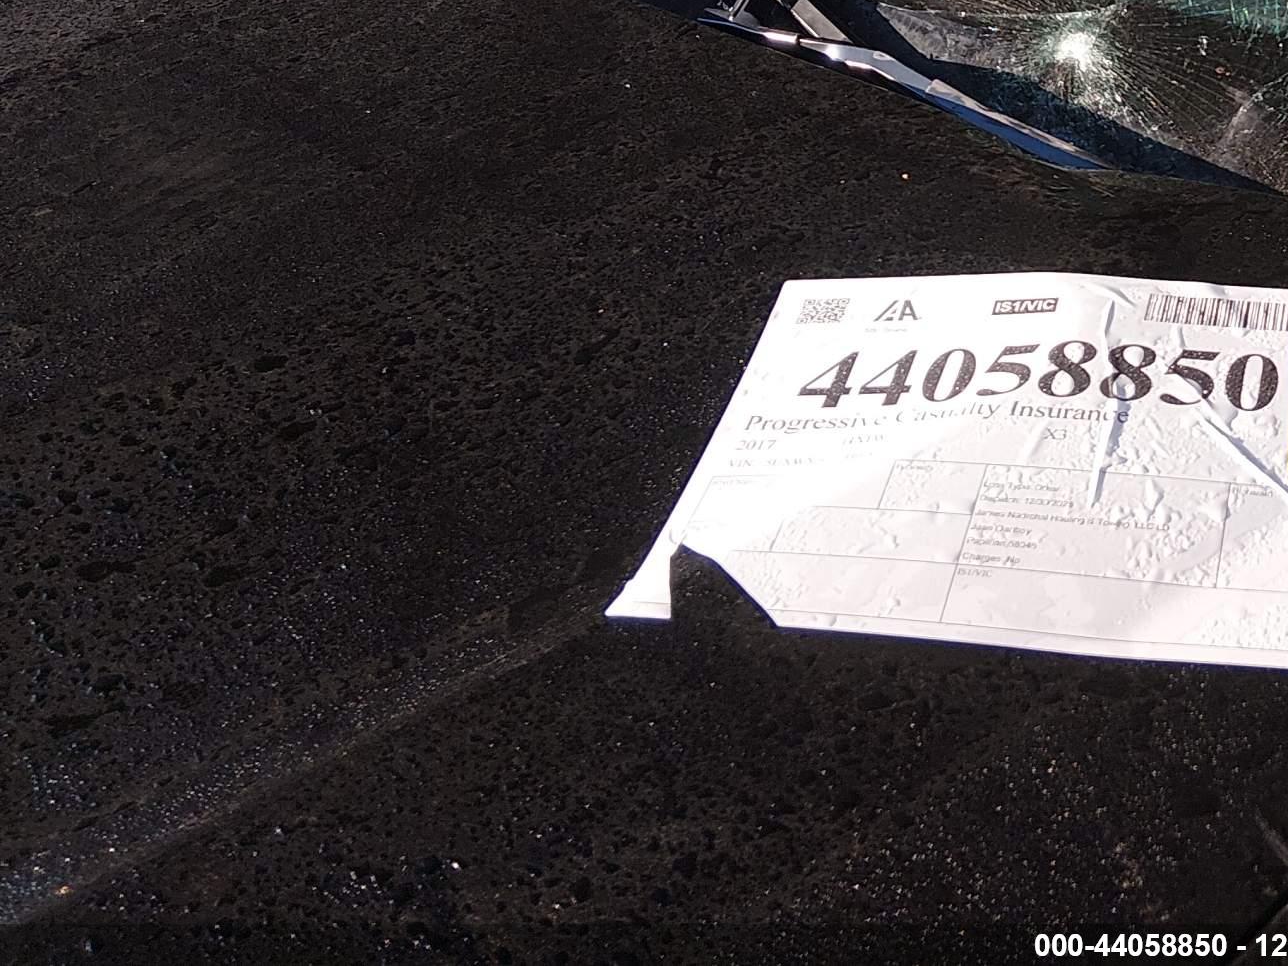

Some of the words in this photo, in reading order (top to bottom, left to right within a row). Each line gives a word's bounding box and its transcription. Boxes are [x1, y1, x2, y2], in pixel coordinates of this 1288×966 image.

[797, 340, 1278, 412] 44058850
[1008, 399, 1130, 423] Insurance
[1044, 427, 1068, 441] X3
[735, 439, 777, 451] 2017
